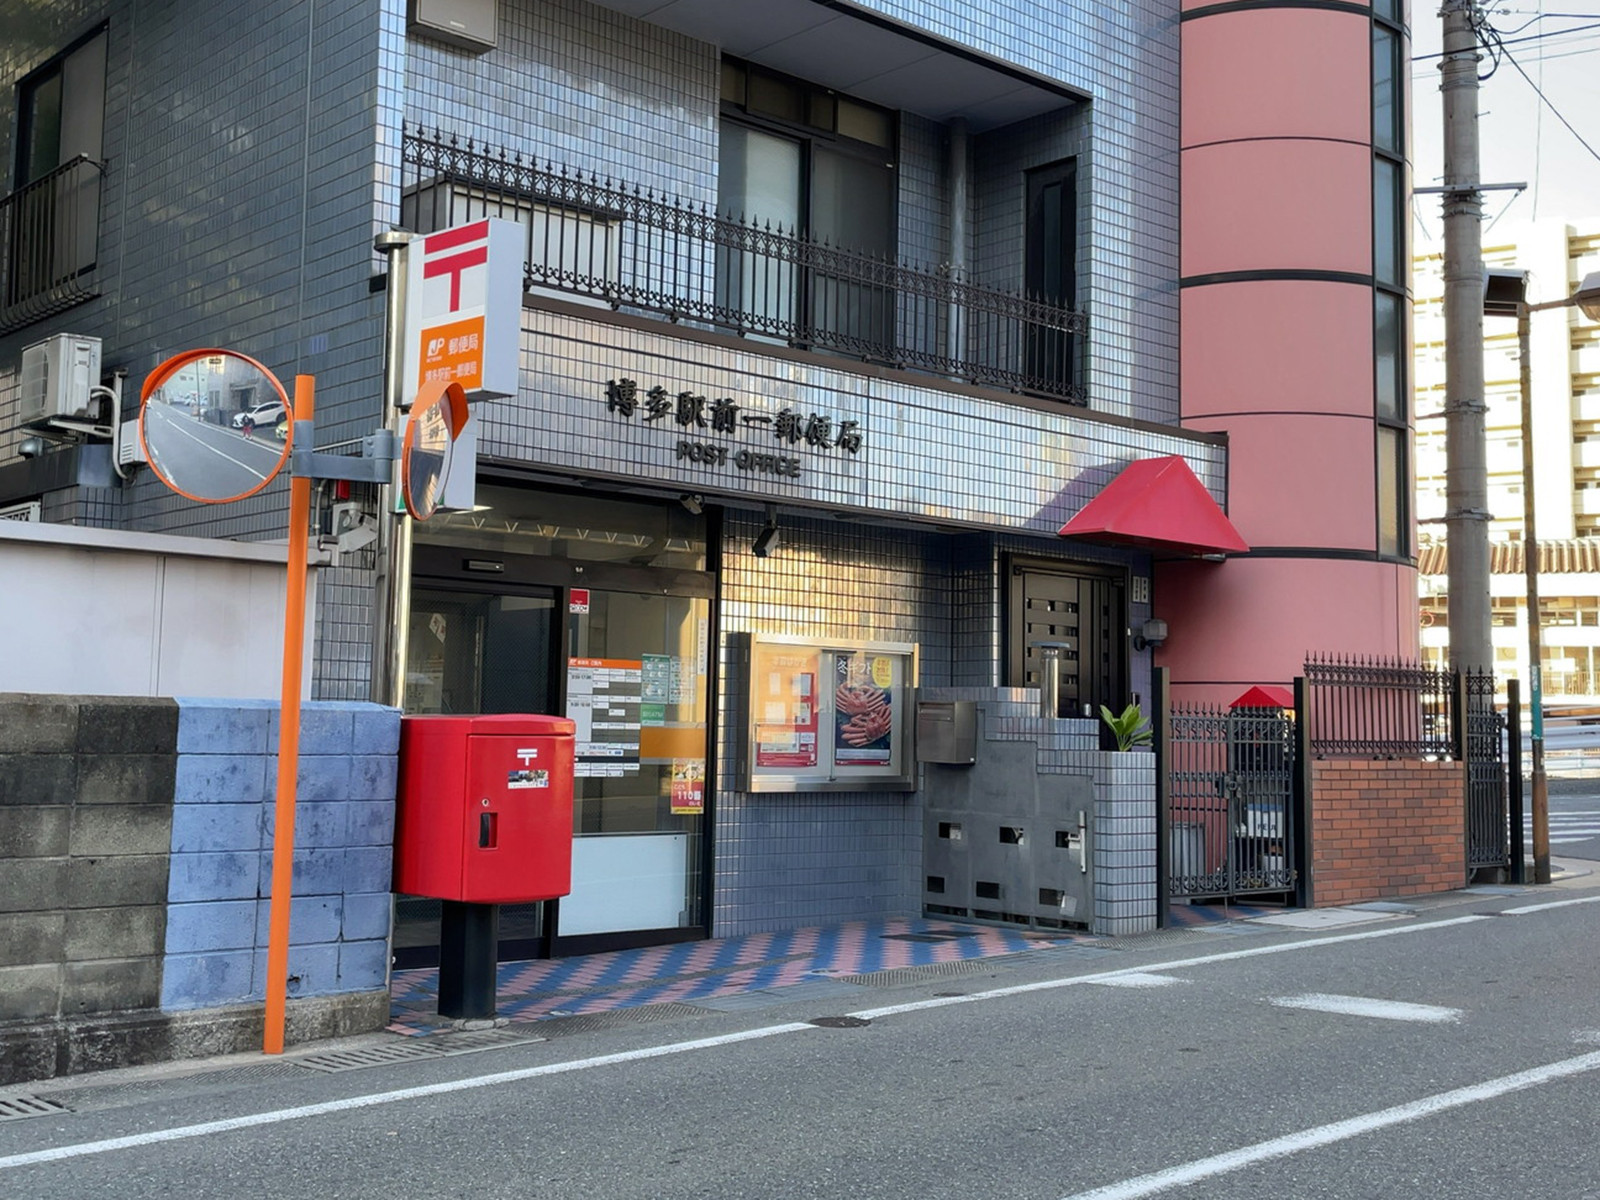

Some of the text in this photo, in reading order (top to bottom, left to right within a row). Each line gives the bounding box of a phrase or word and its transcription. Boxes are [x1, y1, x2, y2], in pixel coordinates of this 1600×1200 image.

[447, 333, 479, 355] 郵便局
[604, 377, 864, 454] 博多駅前一郵便局
[676, 440, 801, 478] POST OFFICE
